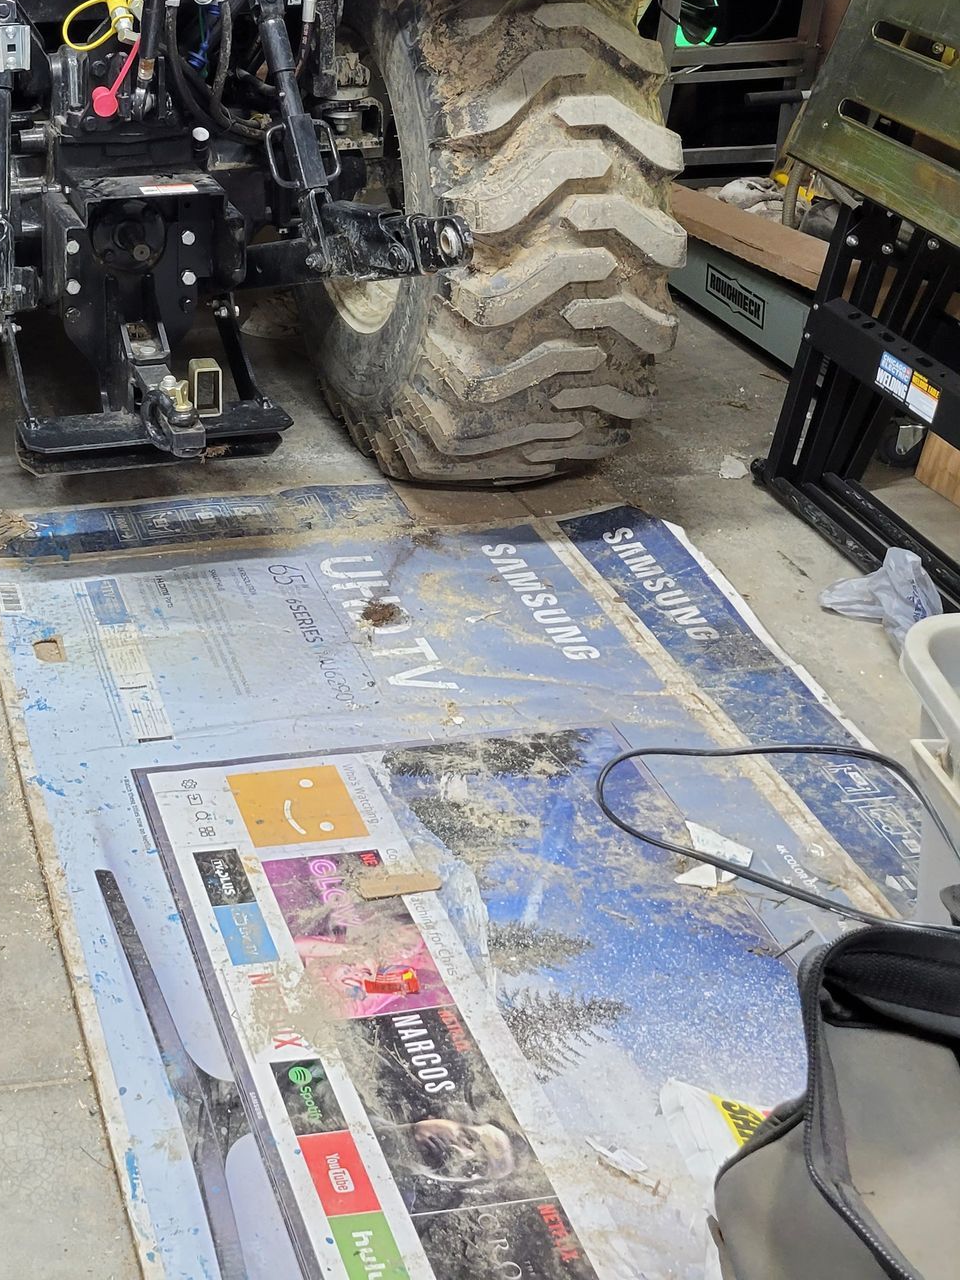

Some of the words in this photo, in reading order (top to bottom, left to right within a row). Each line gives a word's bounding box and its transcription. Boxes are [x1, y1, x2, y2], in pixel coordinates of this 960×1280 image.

[709, 272, 761, 321] ROUGHNECK
[875, 366, 908, 400] WELDING
[480, 542, 601, 661] SAMSUNG
[603, 526, 721, 642] SAMSUNG
[371, 636, 461, 691] TV
[392, 1012, 456, 1094] NARCOS
[323, 1151, 354, 1194] YouTube
